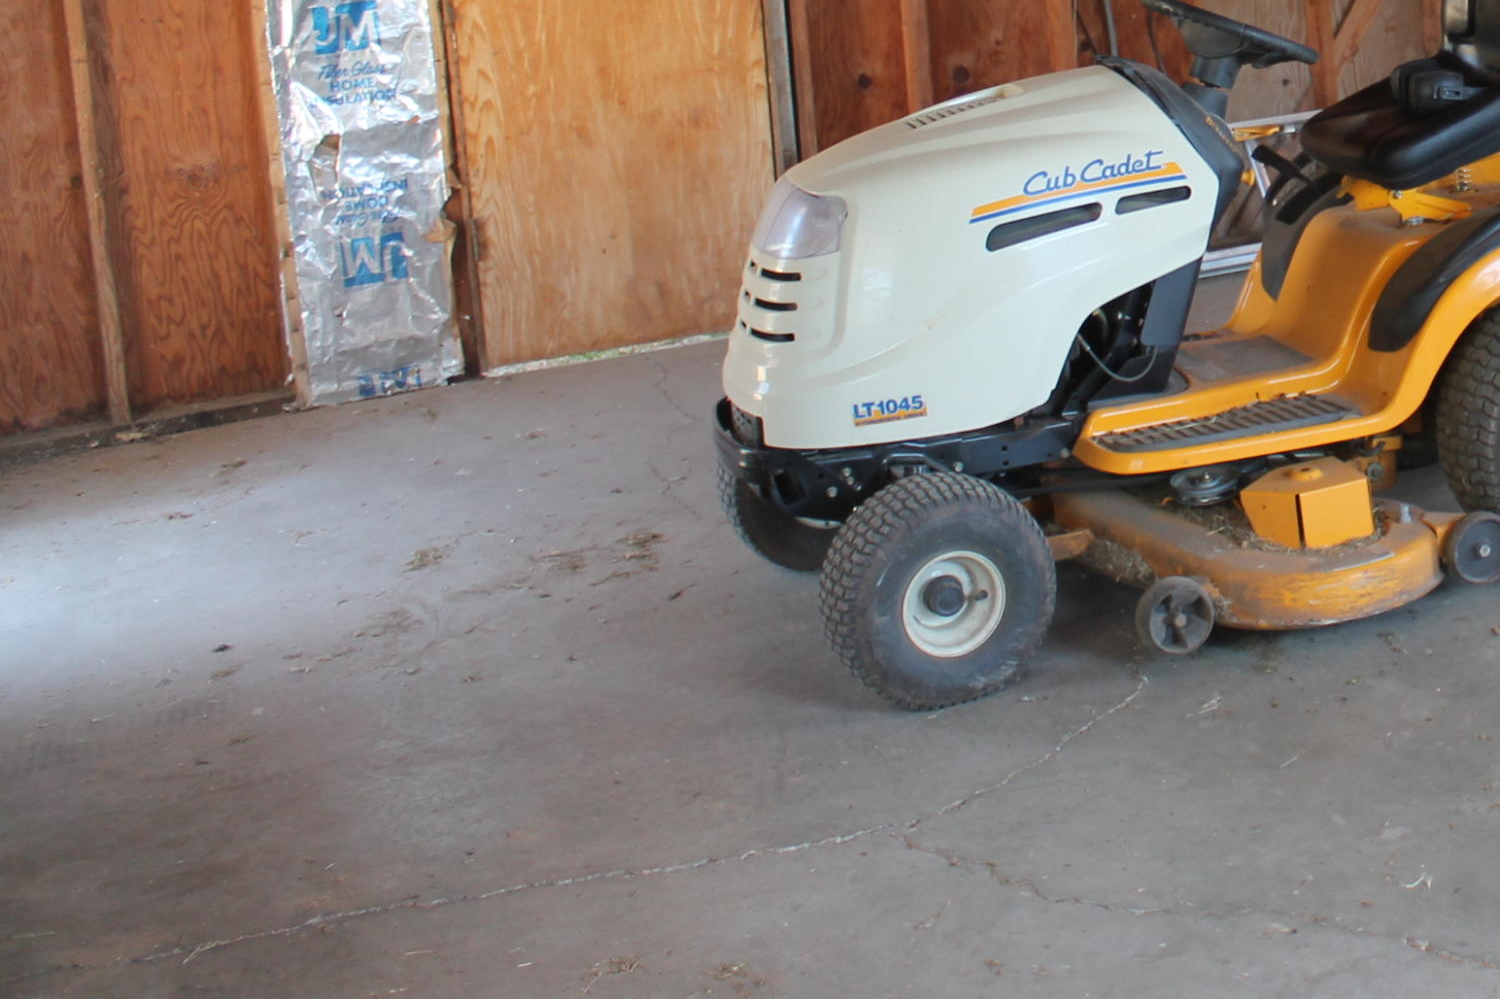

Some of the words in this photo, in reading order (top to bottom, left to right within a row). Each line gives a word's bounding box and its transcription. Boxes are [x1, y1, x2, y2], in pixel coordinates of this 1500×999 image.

[312, 0, 380, 54] JM
[330, 77, 376, 92] HOME
[1022, 166, 1077, 196] Cub
[1080, 150, 1164, 184] Cadet
[339, 232, 410, 288] JM
[852, 394, 924, 419] LT1045
